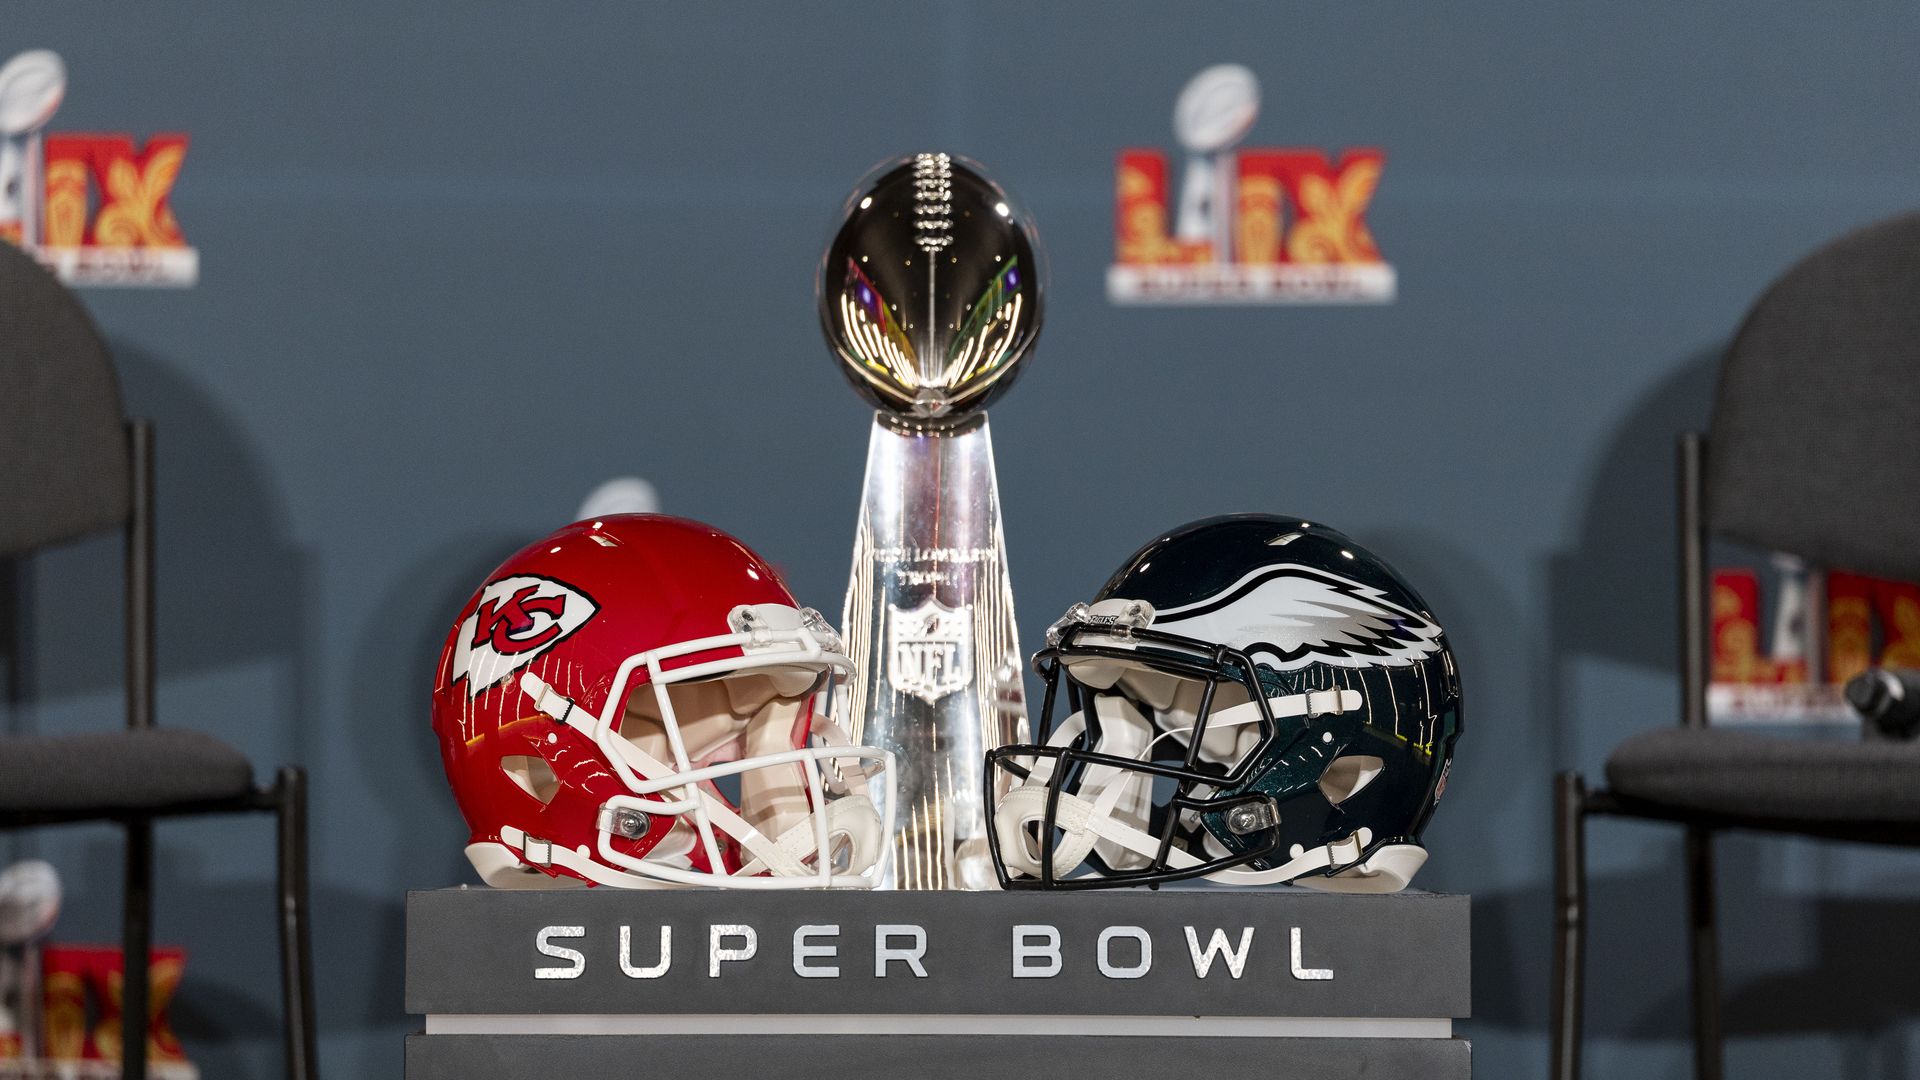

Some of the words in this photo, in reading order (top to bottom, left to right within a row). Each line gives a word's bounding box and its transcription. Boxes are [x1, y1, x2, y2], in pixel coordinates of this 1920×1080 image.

[0, 130, 190, 249] IX
[1115, 149, 1387, 265] LIX
[472, 584, 567, 655] KC
[896, 641, 961, 685] NFL
[534, 924, 929, 980] SUPER
[1012, 924, 1334, 981] BOWL
